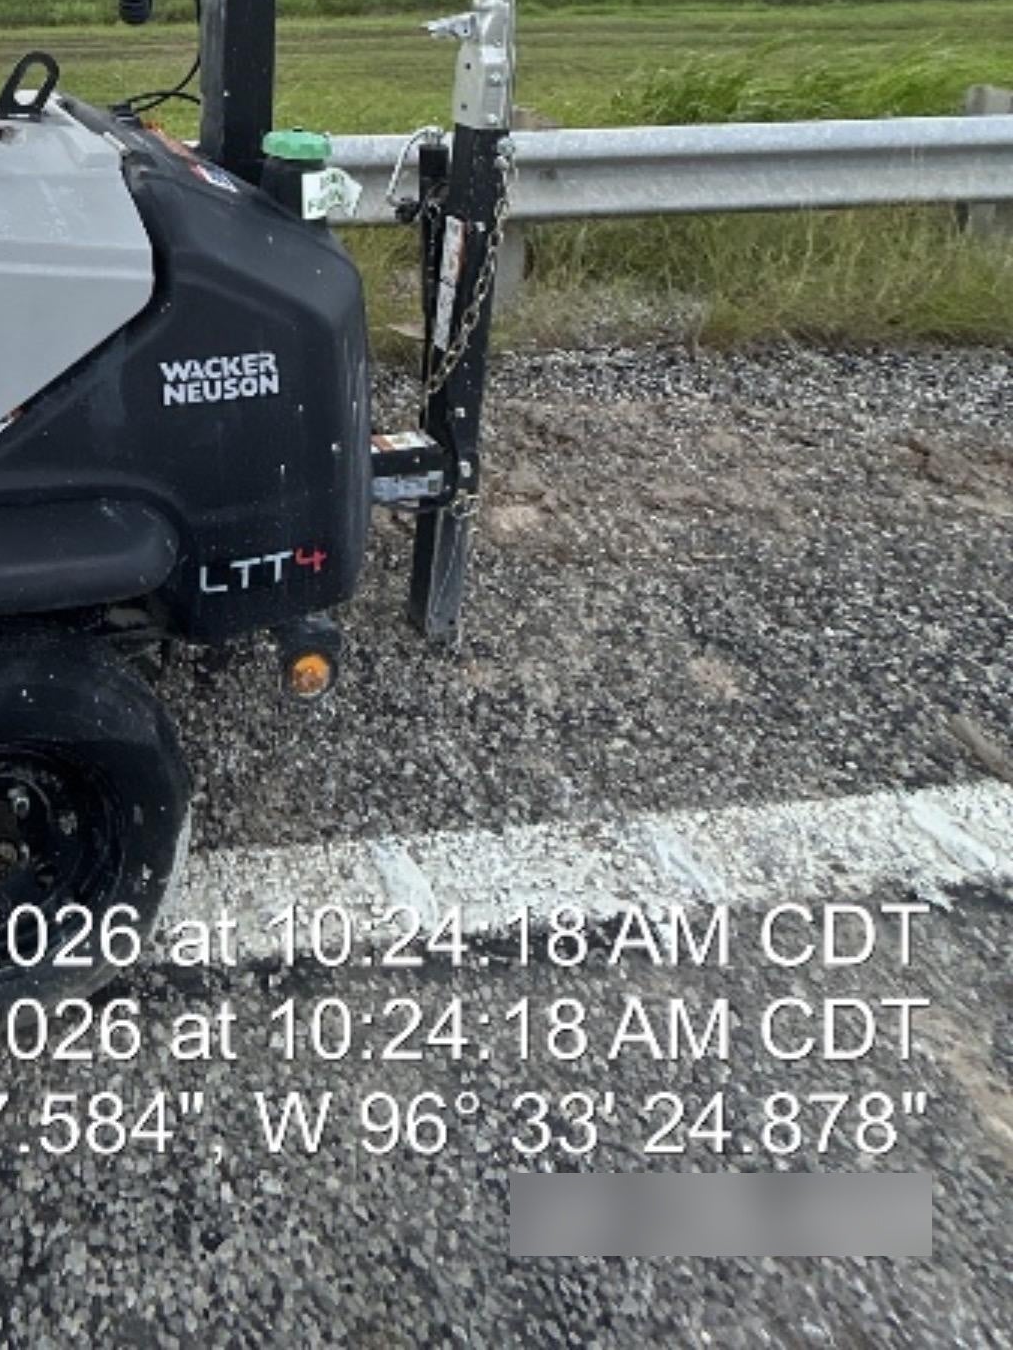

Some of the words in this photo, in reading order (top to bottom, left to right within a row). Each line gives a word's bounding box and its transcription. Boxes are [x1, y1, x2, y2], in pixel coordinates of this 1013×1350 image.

[159, 351, 278, 382] WACKER
[163, 372, 279, 406] NEUSON
[199, 548, 327, 593] LTT4
